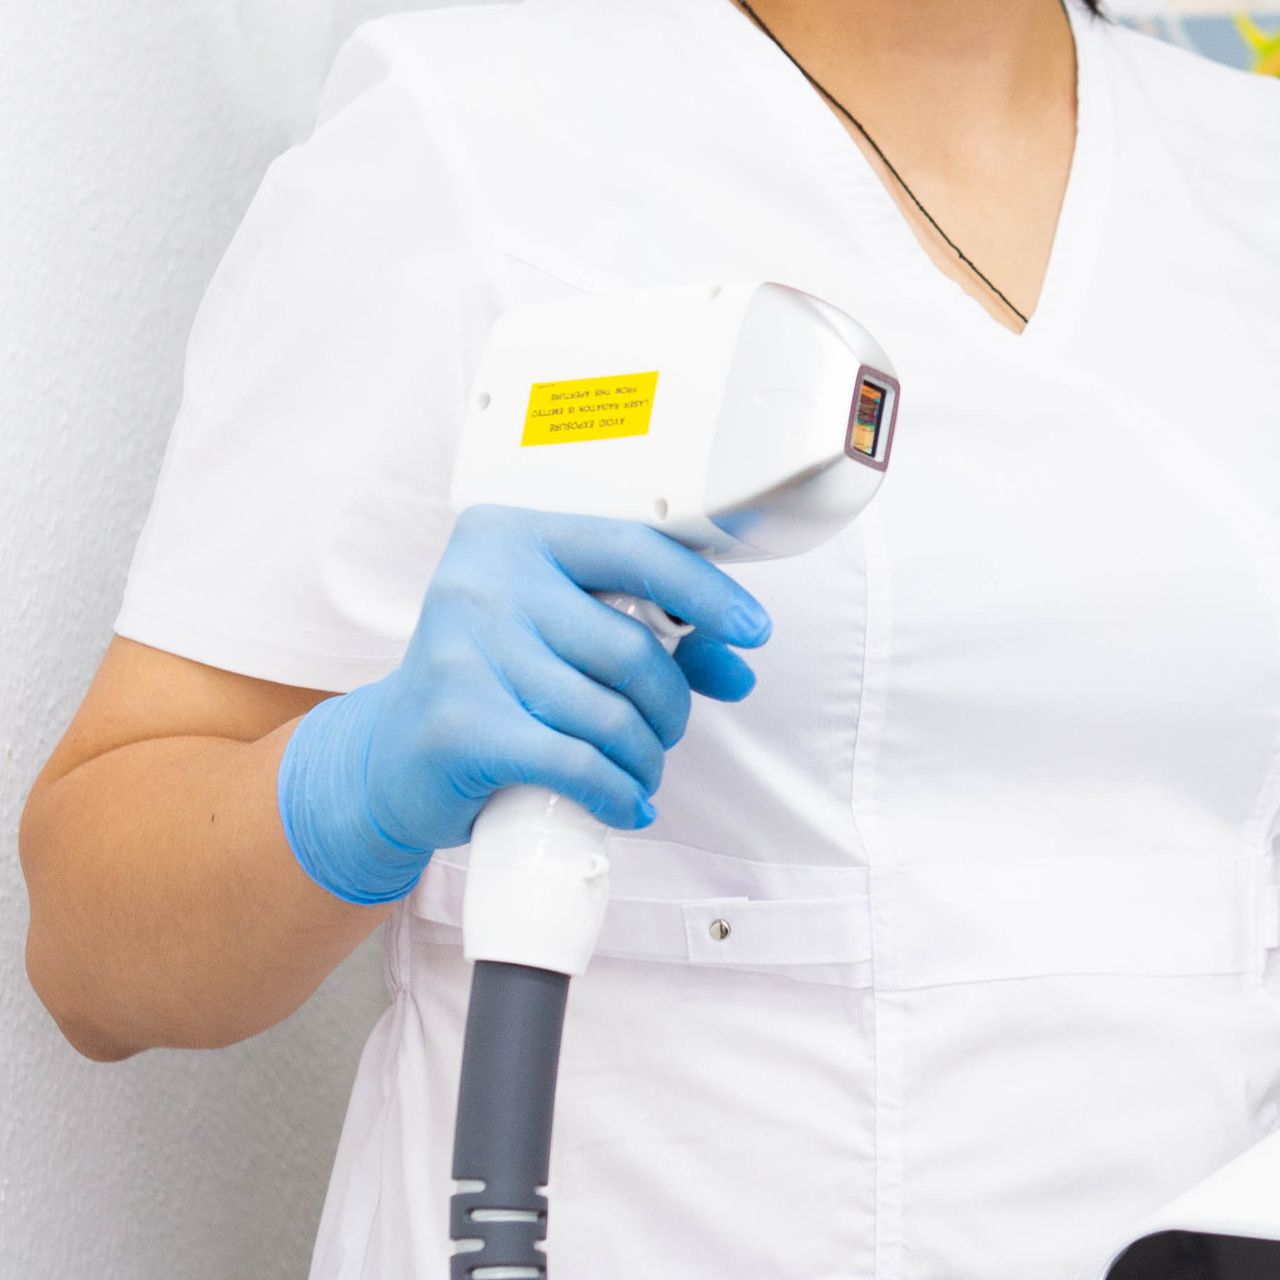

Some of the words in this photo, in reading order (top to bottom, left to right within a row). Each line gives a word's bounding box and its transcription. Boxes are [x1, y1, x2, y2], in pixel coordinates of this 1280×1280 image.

[550, 391, 591, 402] APERTURE
[579, 402, 620, 413] RADIATION
[549, 419, 595, 432] EXPOSURE
